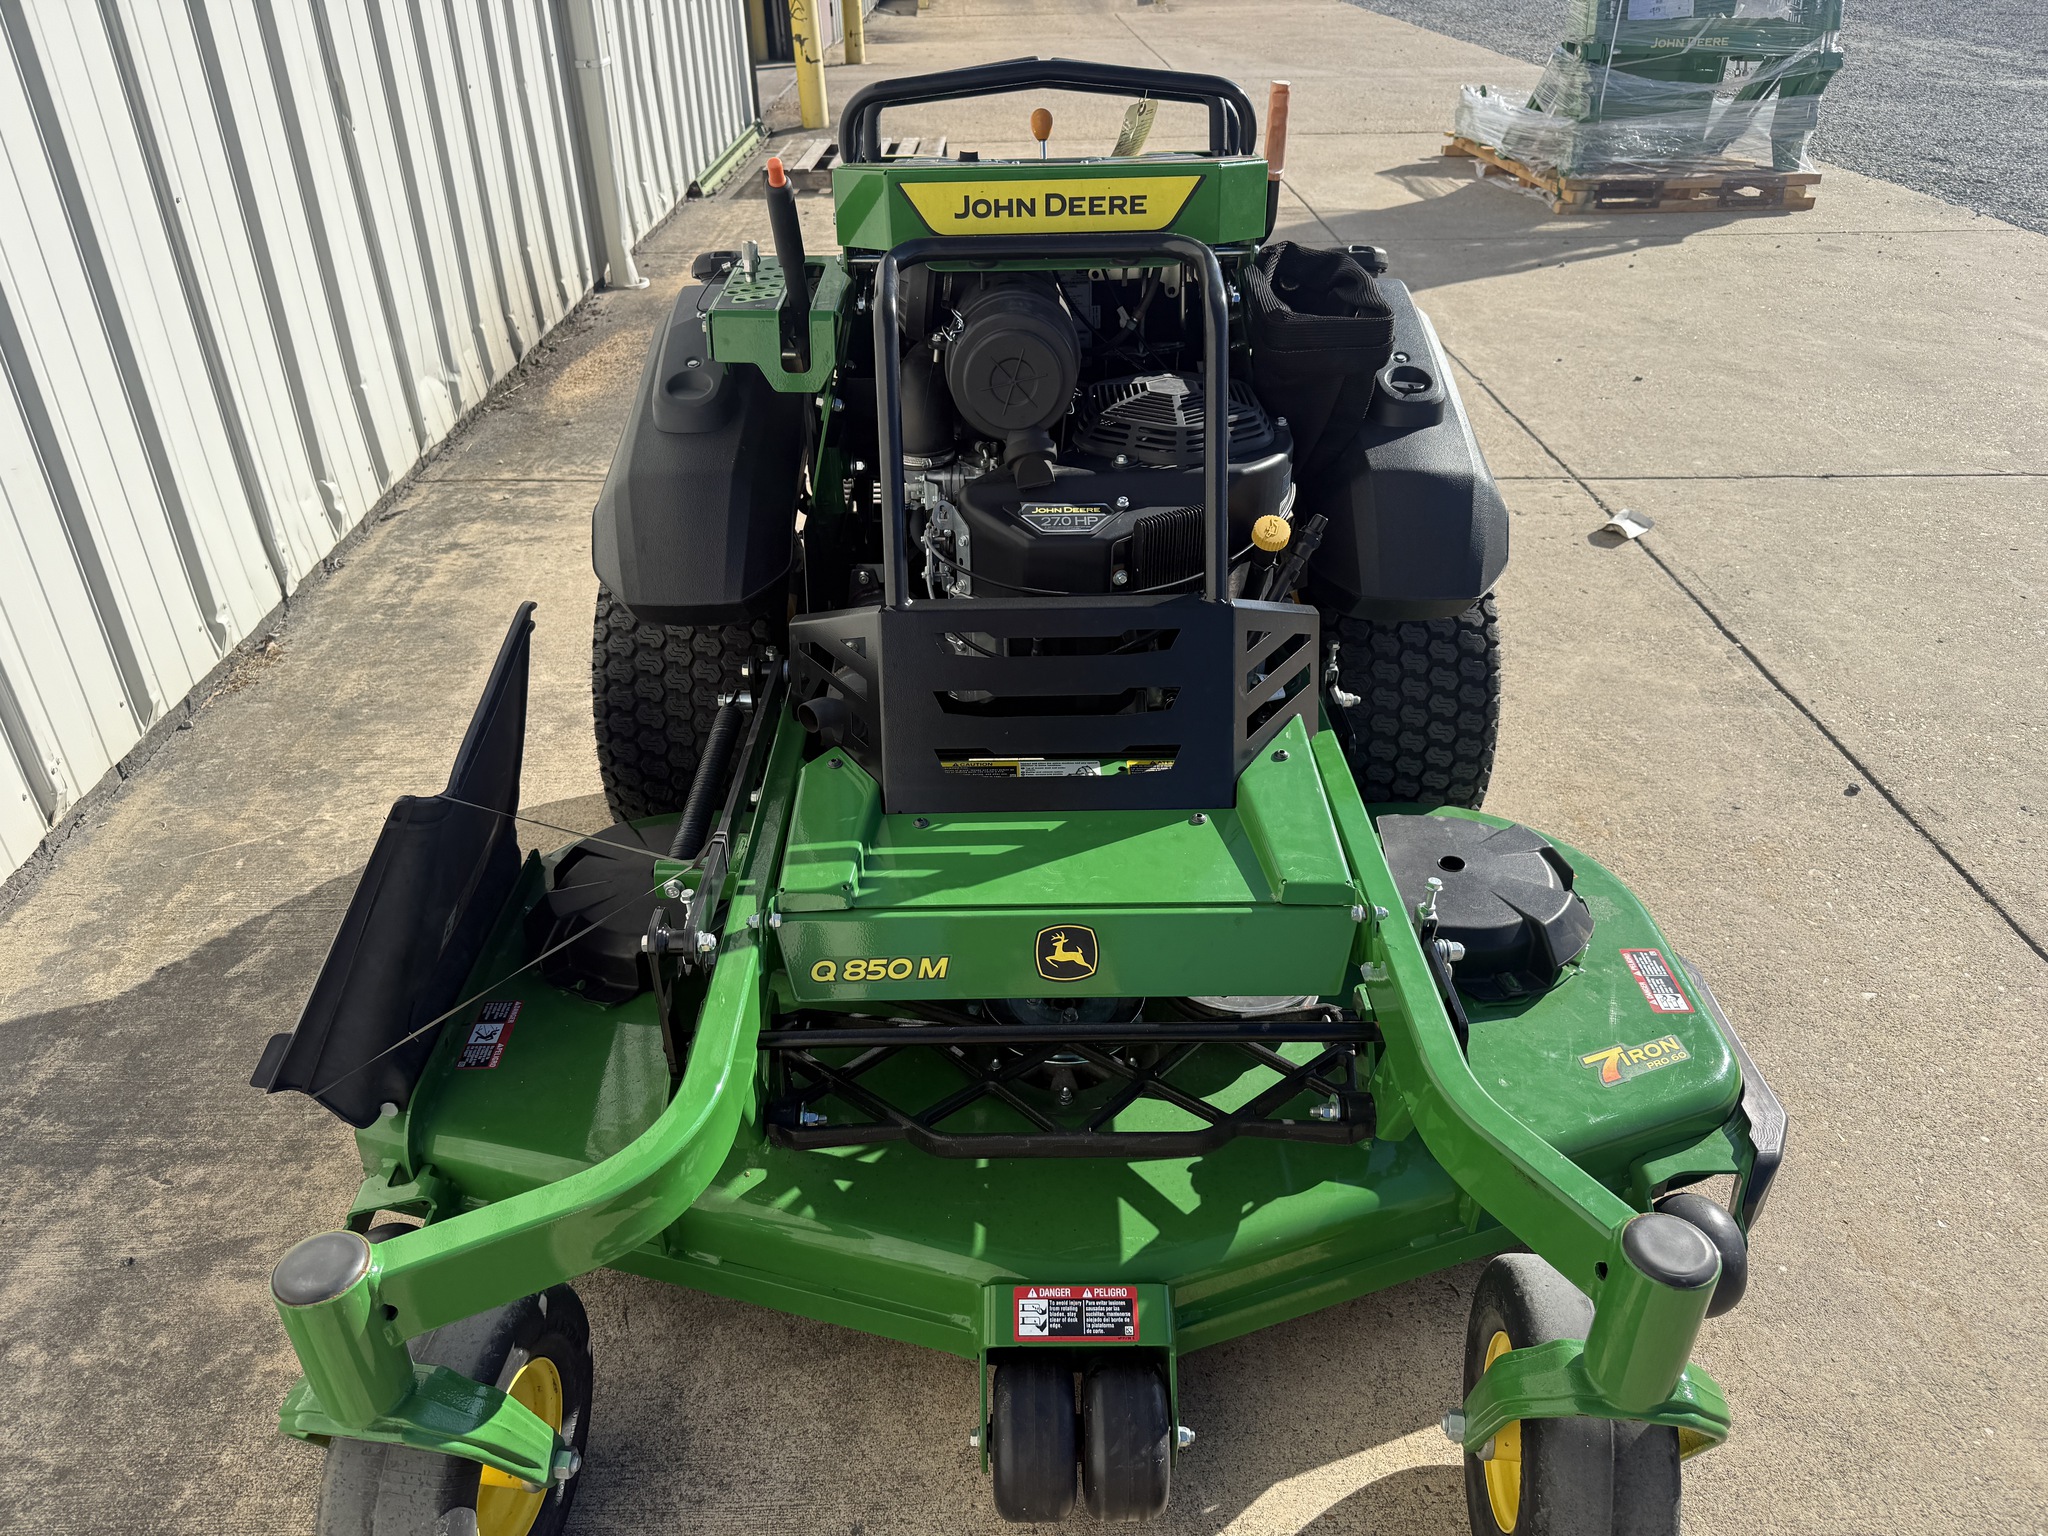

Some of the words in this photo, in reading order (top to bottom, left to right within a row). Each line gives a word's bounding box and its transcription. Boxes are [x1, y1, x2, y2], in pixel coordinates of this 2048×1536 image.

[1650, 37, 1685, 49] JOHN
[954, 194, 1036, 219] JOHN
[1044, 193, 1148, 217] DEERE
[1031, 506, 1061, 514] JOHN
[1040, 516, 1072, 526] 27.0
[1074, 516, 1099, 526] HP
[810, 958, 837, 982] Q
[842, 957, 914, 981] 850
[916, 956, 950, 980] M
[1646, 1057, 1670, 1070] PRO
[1671, 1051, 1687, 1061] 60
[1039, 1288, 1071, 1297] DANGER
[1094, 1288, 1128, 1297] PELIGRO
